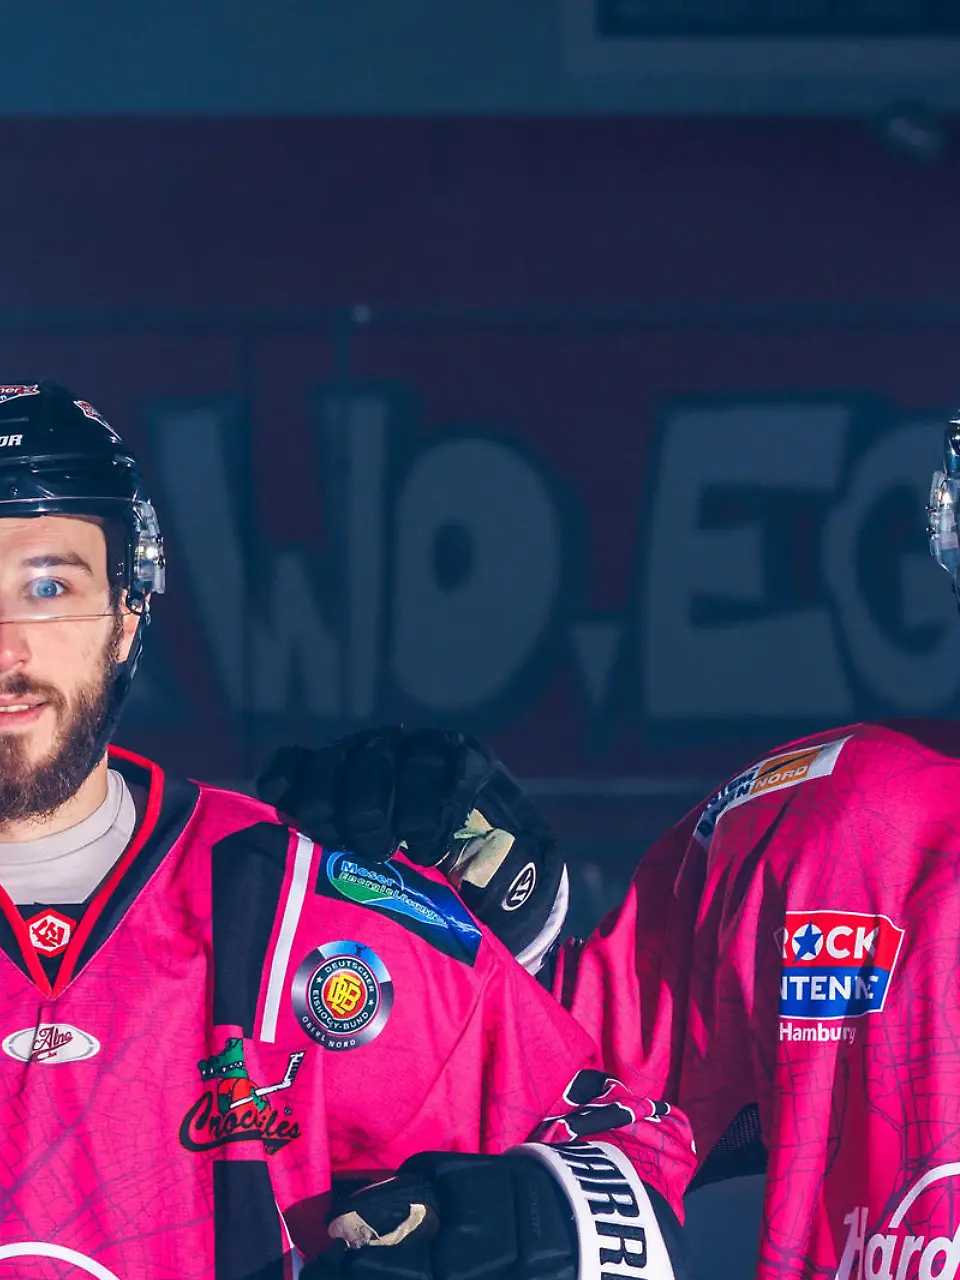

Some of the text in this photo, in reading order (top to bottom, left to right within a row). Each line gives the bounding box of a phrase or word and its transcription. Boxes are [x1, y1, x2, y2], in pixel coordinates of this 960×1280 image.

[755, 765, 808, 788] NORD
[340, 859, 395, 888] Moser
[324, 959, 376, 993] DEUTSCHER
[779, 1022, 857, 1044] Hamburg
